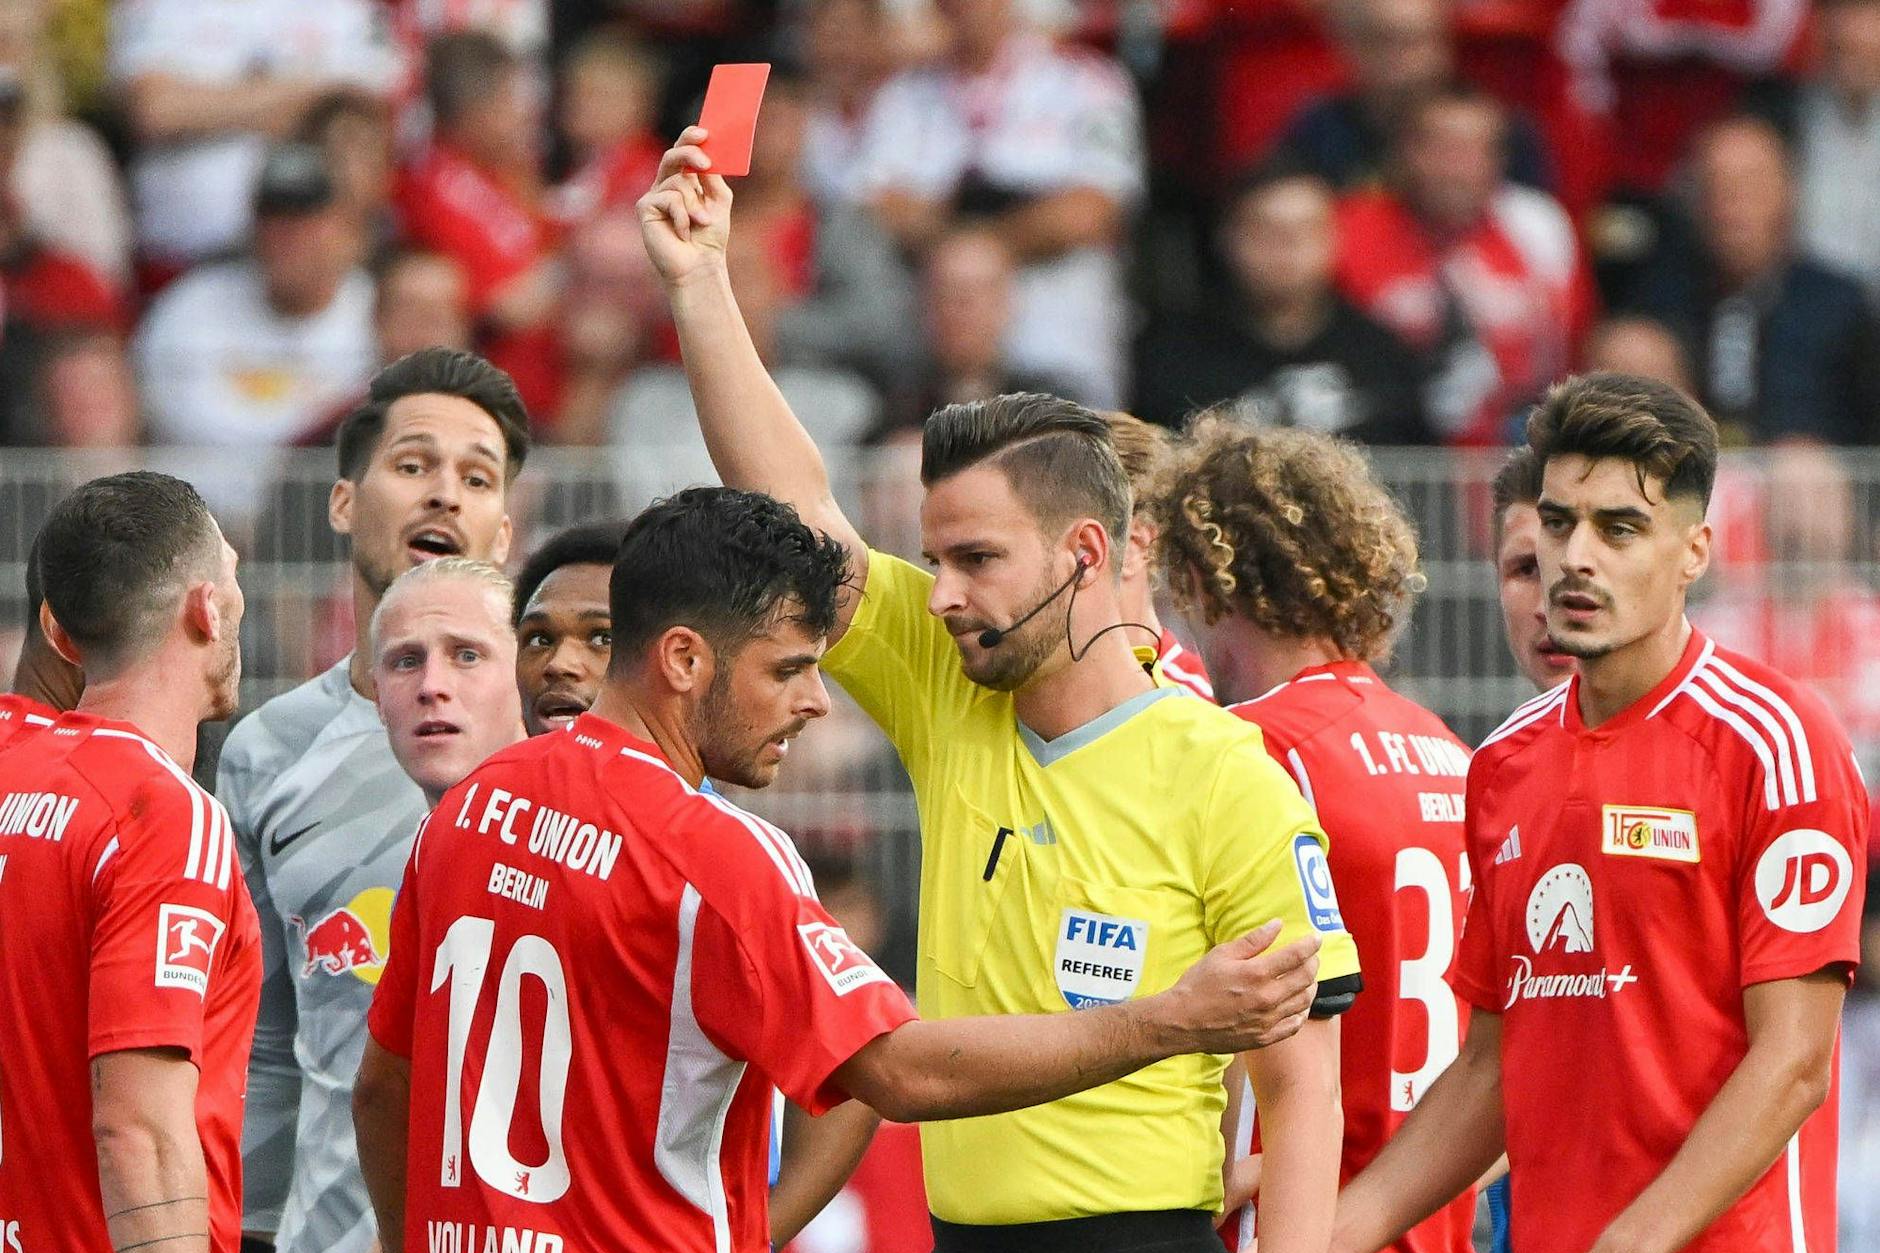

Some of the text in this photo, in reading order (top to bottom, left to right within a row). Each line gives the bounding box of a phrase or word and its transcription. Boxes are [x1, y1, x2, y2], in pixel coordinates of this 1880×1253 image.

[1349, 731, 1388, 775] 1.
[1377, 731, 1420, 774] FC
[455, 782, 623, 881] 1. FC UNION
[1653, 828, 1690, 849] UNION
[488, 861, 549, 911] BERLIN
[1770, 852, 1840, 911] JD
[1066, 916, 1137, 951] FIFA
[1061, 959, 1134, 982] REFEREE
[430, 915, 573, 1204] 10
